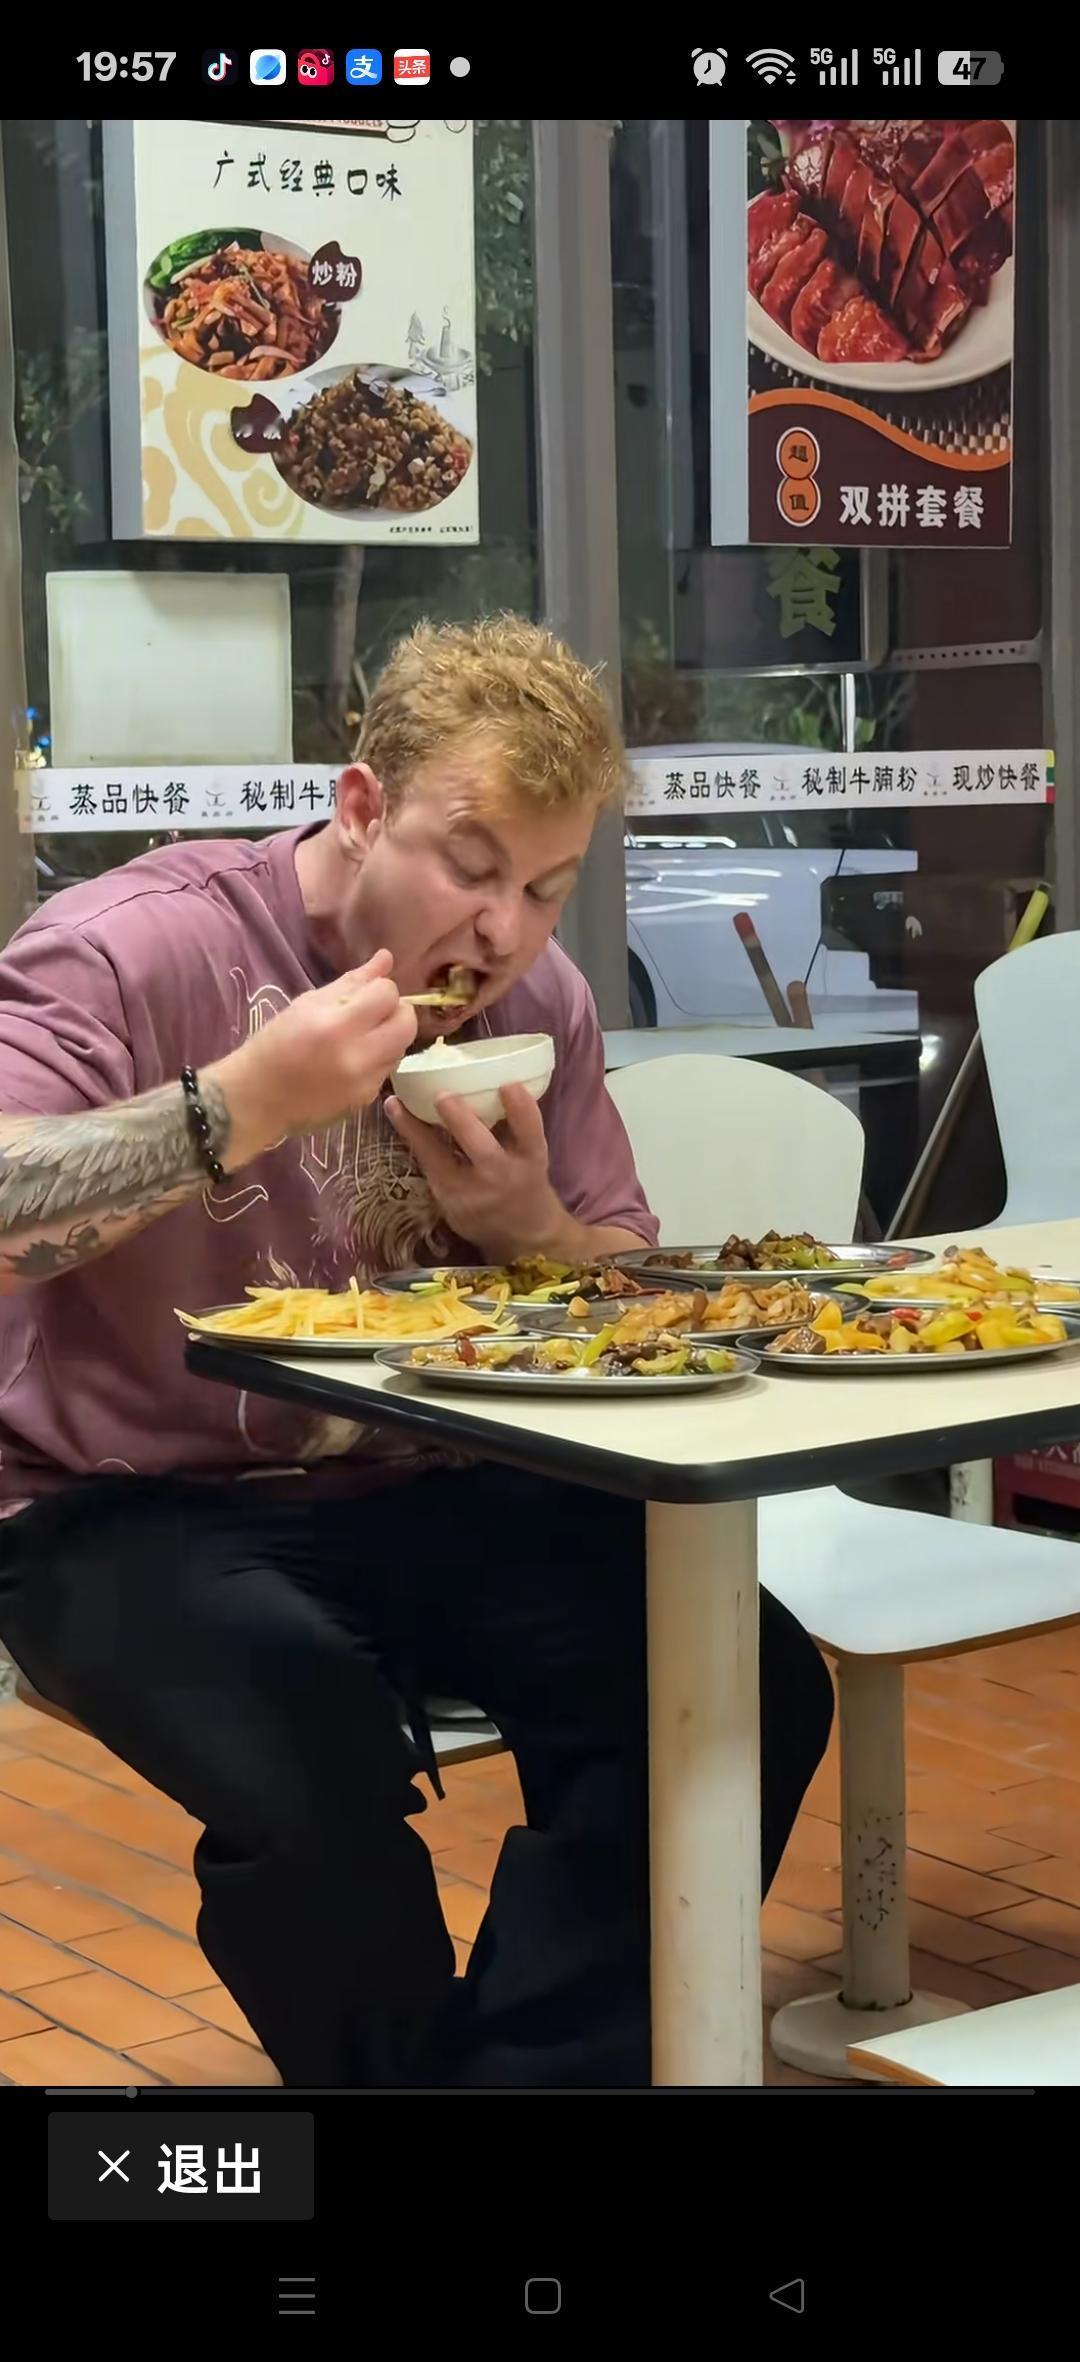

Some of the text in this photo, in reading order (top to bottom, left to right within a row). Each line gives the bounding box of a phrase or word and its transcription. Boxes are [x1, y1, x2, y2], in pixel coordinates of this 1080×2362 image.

[213, 150, 402, 201] 广式经典口味
[311, 260, 357, 287] 炒粉
[838, 484, 985, 530] 双拼套餐
[69, 782, 190, 815] 蒸品快餐
[663, 763, 1040, 800] 蒸品快餐 秘制牛腩粉 现炒快餐
